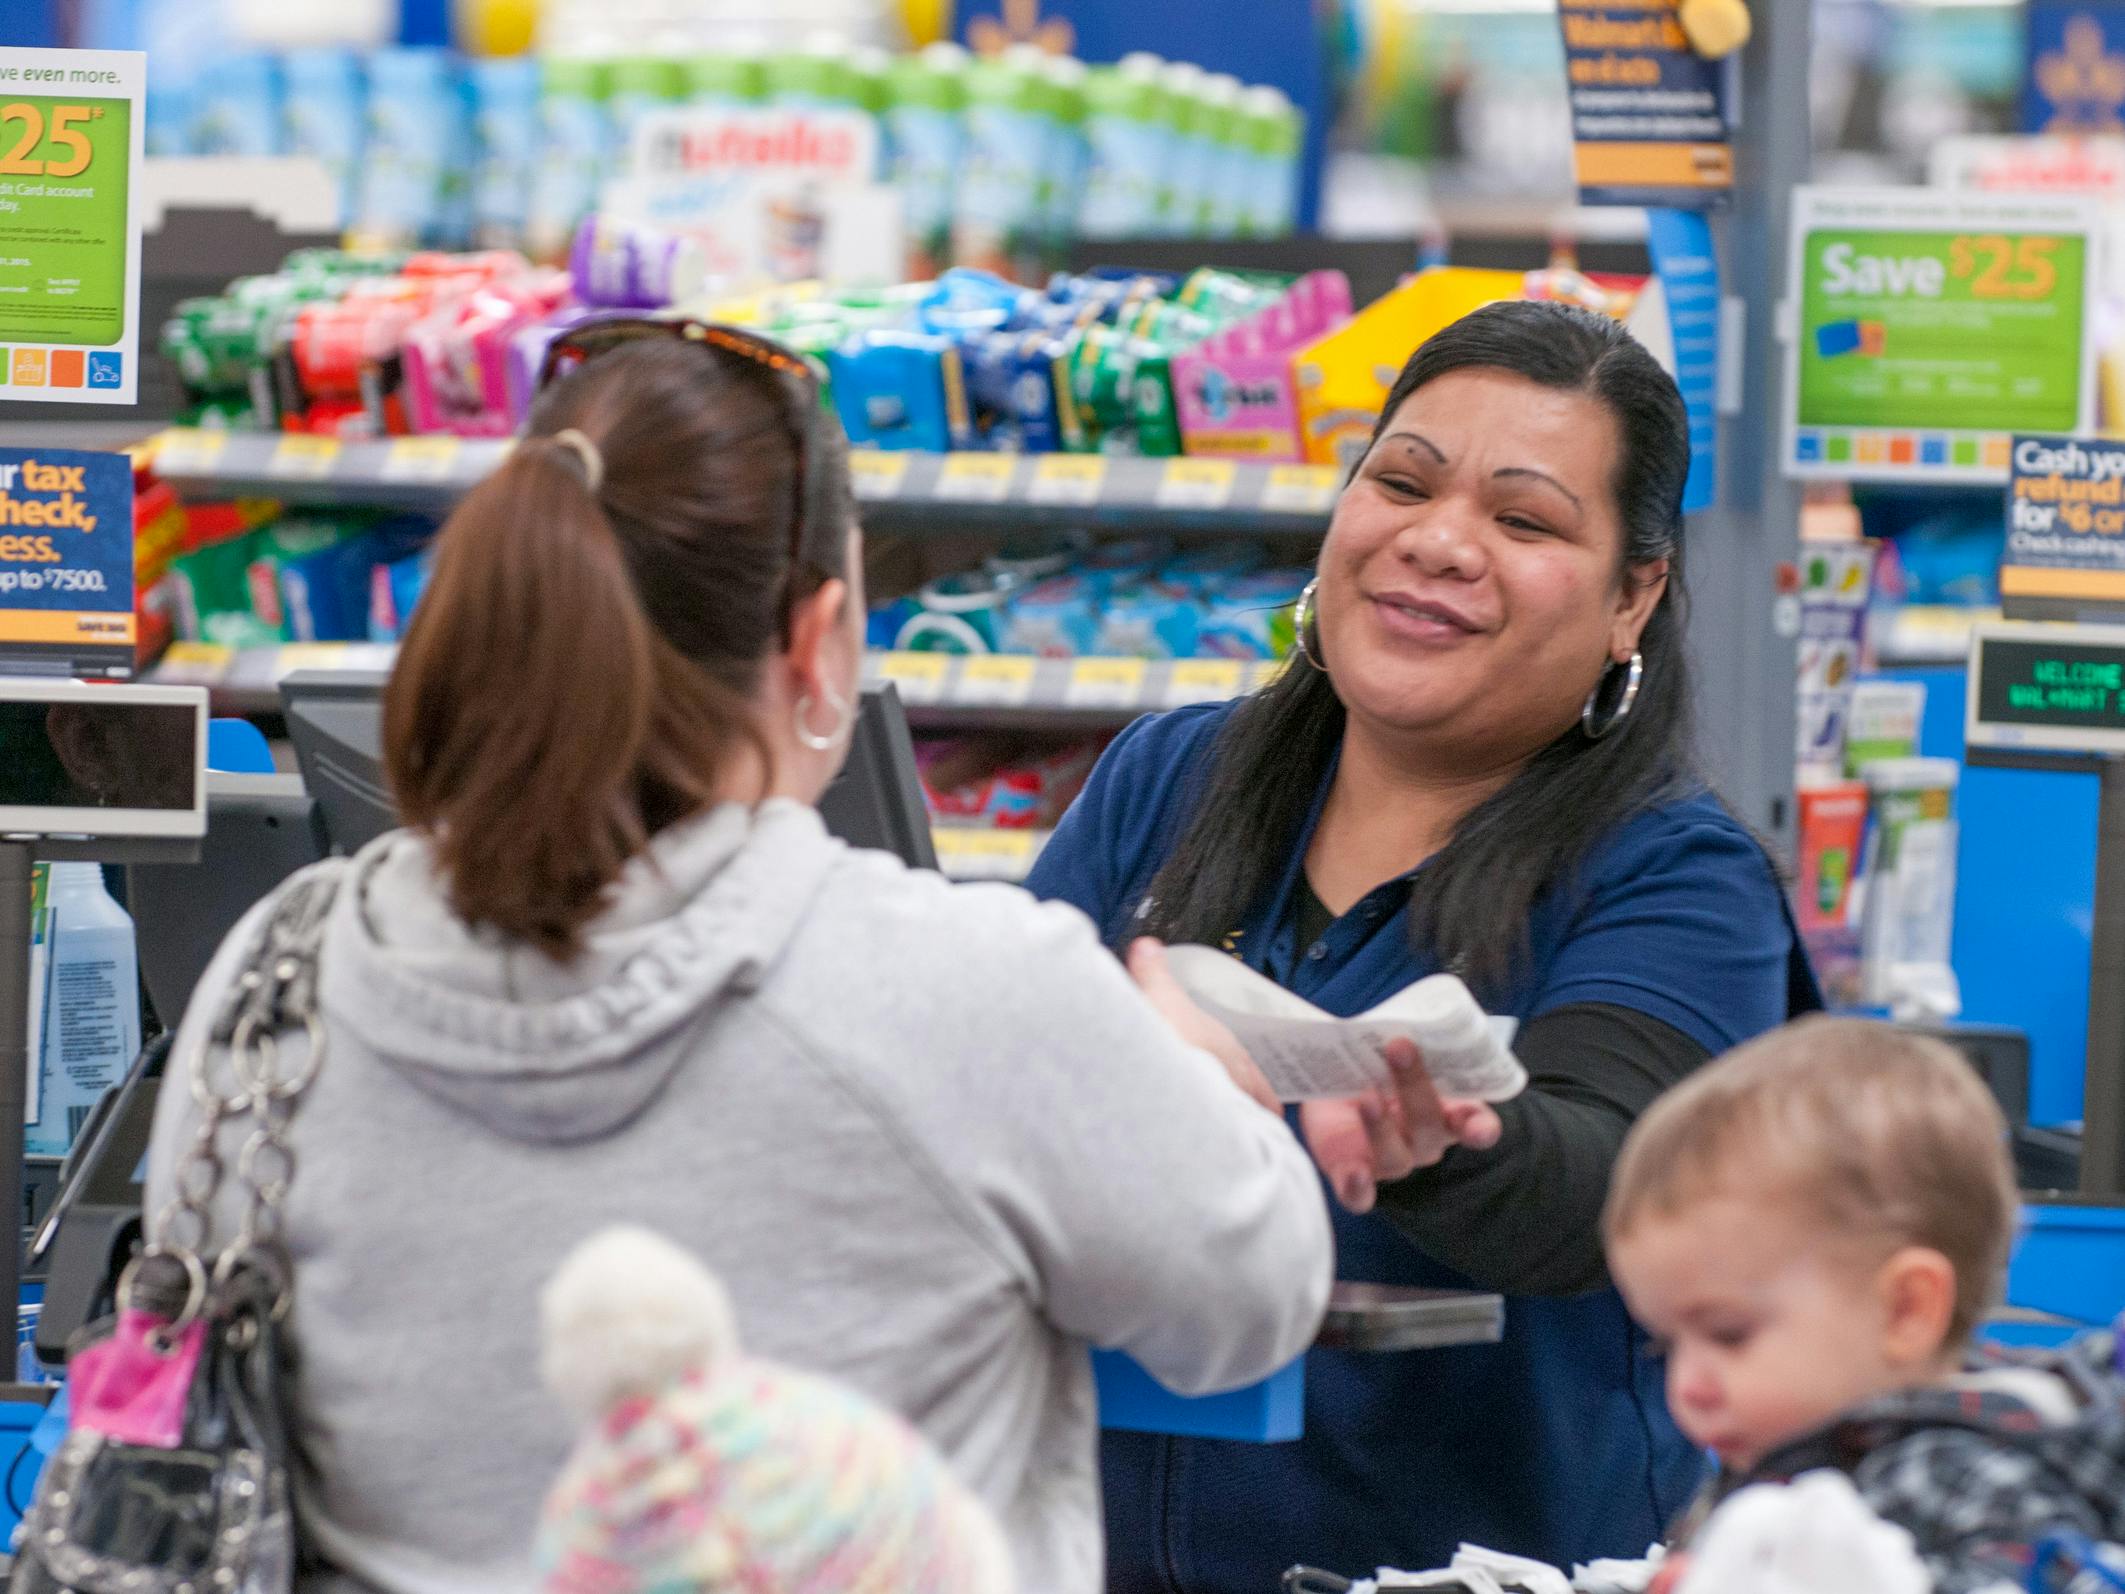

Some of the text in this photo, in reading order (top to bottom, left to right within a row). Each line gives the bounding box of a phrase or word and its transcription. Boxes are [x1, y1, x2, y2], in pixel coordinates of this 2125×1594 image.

[23, 67, 65, 83] even
[69, 70, 122, 84] more.
[15, 184, 45, 196] Card
[45, 187, 95, 199] account
[1820, 234, 2066, 300] Save $25
[2015, 440, 2089, 476] Cash
[22, 459, 86, 492] tax
[2014, 473, 2122, 505] refund
[0, 490, 97, 534] heck,
[2013, 496, 2057, 532] for
[0, 534, 62, 562] ess.
[19, 568, 43, 591] to
[2034, 659, 2122, 690] WELCOME
